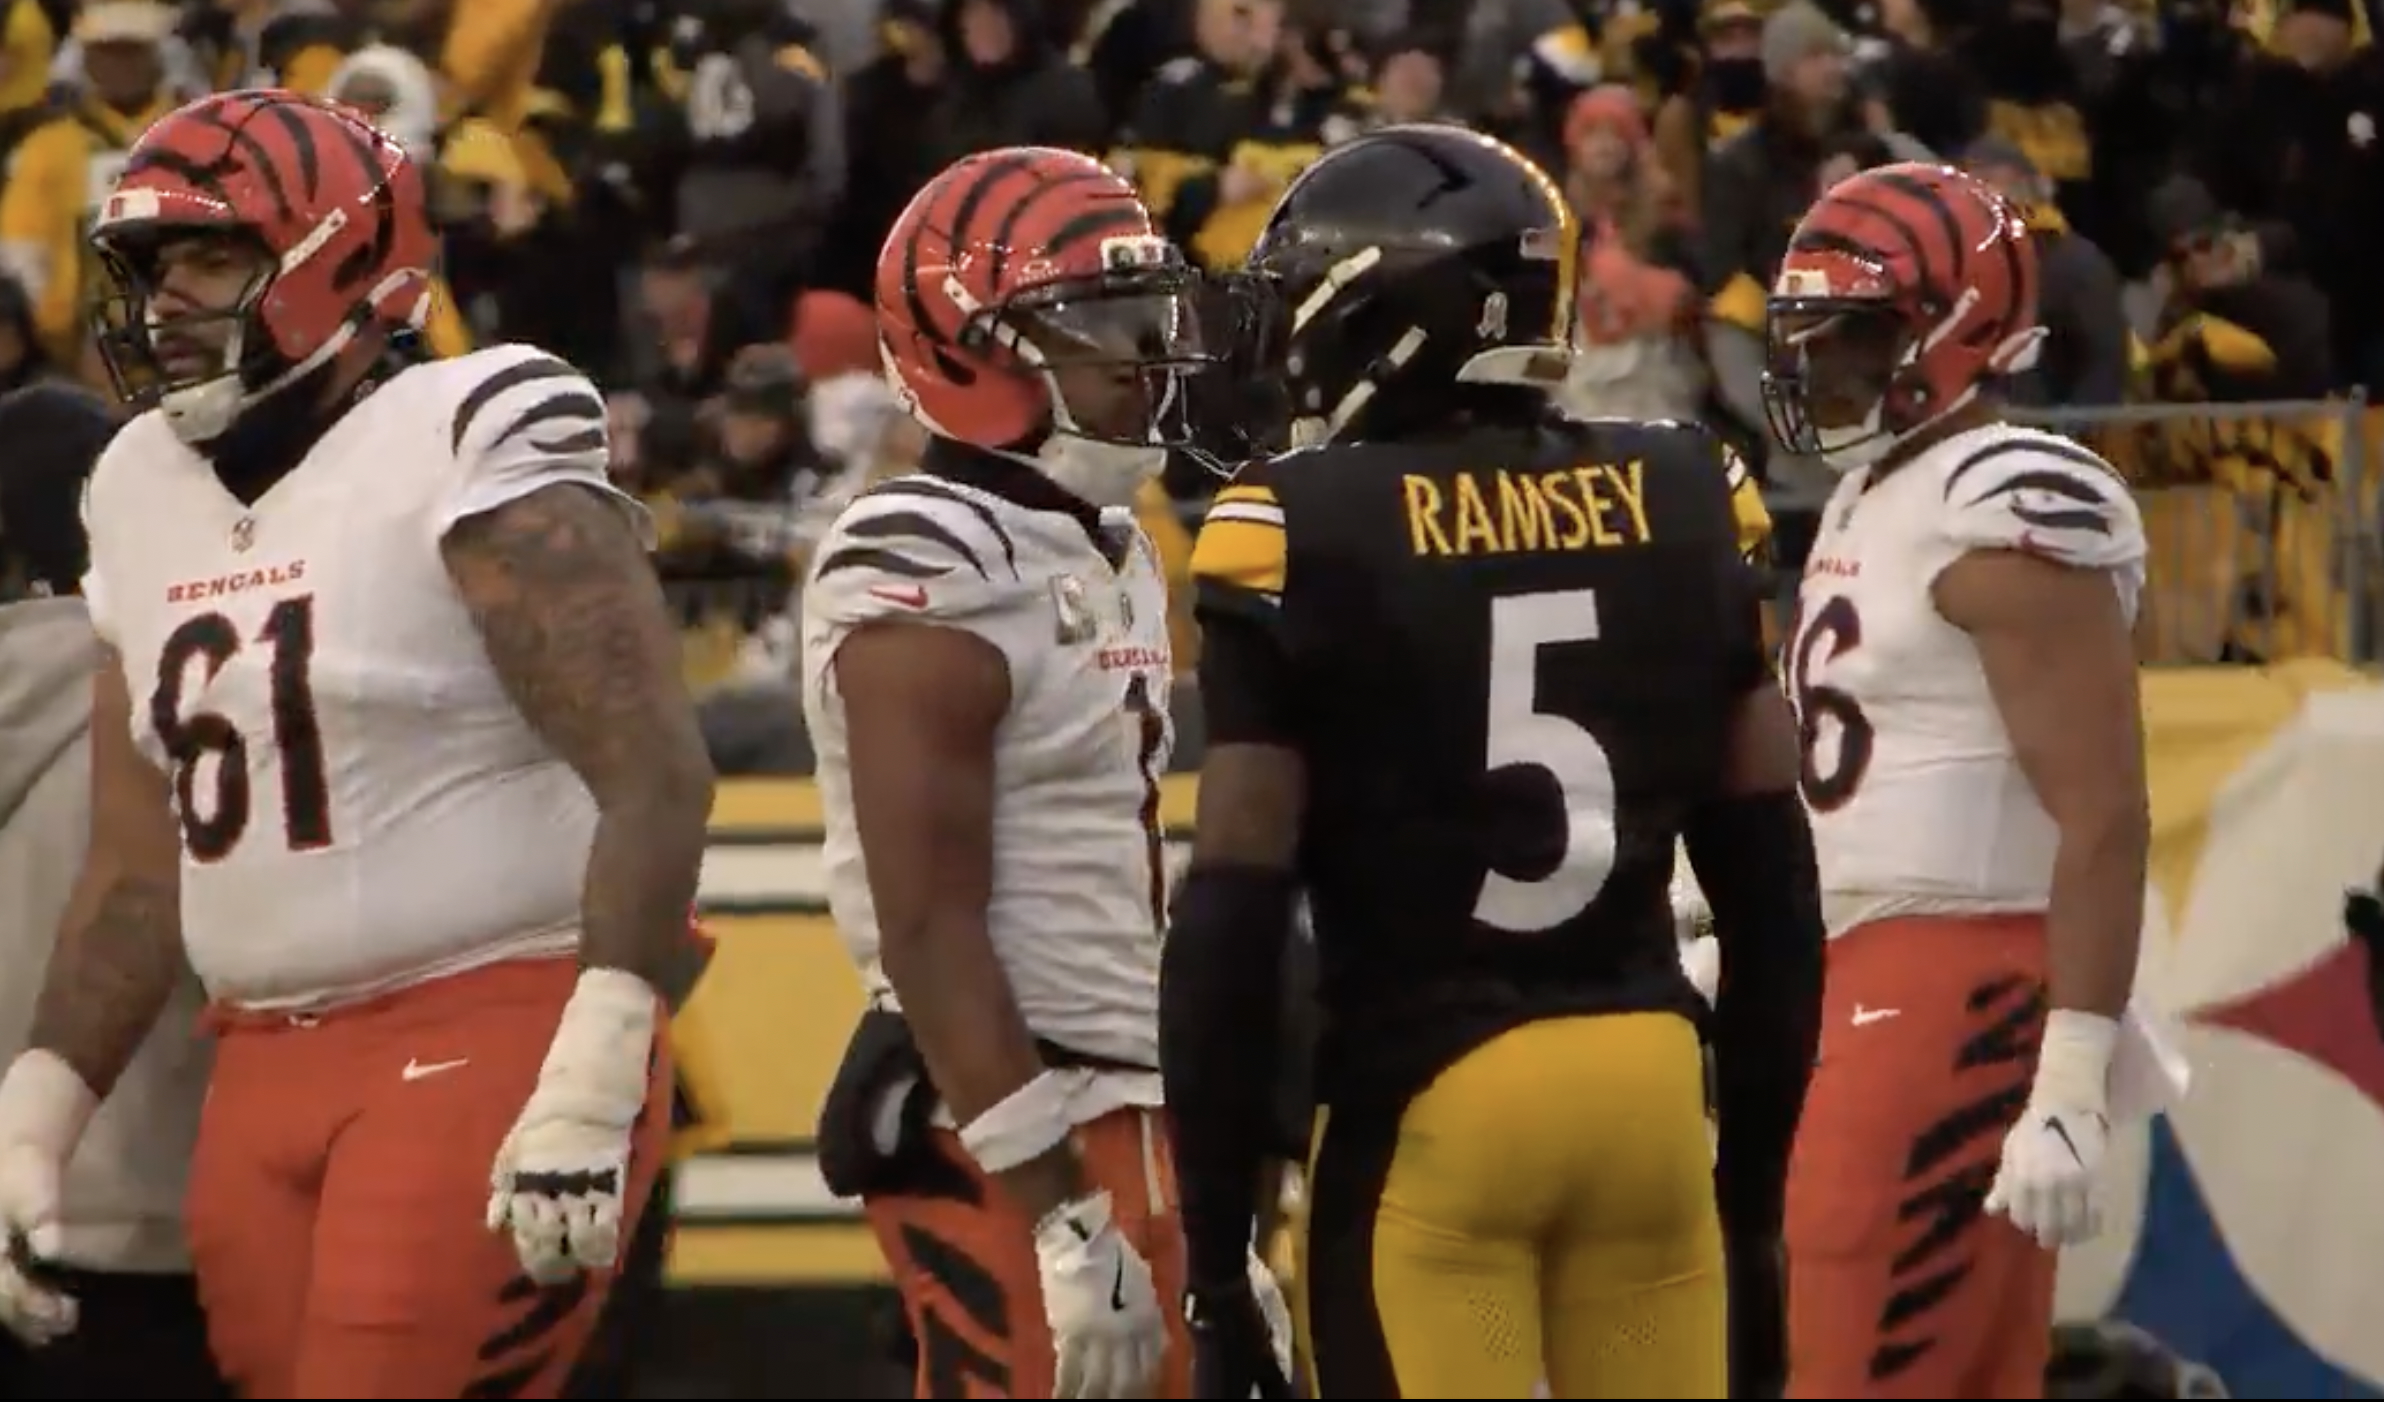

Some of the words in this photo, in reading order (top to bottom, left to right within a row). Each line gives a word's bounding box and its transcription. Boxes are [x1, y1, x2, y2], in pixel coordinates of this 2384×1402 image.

[167, 560, 305, 602] BENGALS
[1403, 461, 1651, 555] RAMSEY
[151, 593, 333, 863] 61
[1472, 589, 1616, 932] 5
[1786, 595, 1874, 813] 6
